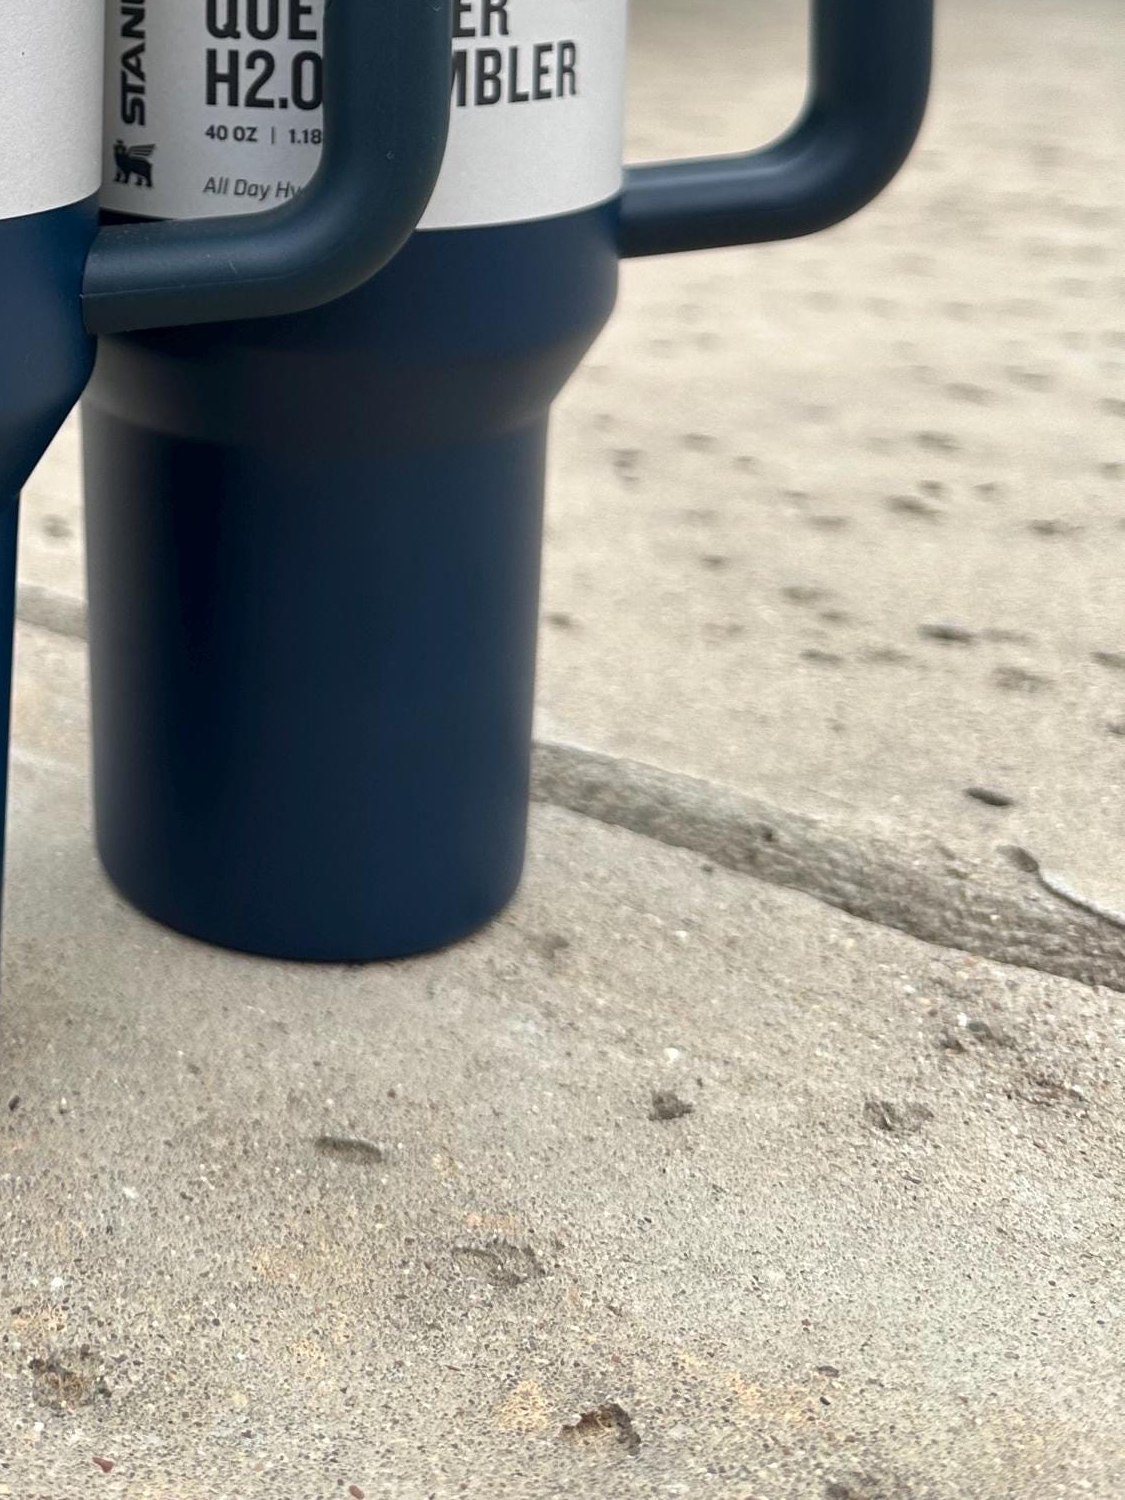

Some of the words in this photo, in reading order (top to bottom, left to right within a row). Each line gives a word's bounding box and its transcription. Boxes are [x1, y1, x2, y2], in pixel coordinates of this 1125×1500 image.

[205, 124, 228, 141] 40
[232, 126, 258, 143] OZ
[288, 128, 322, 145] 1.18
[203, 176, 229, 196] All
[233, 178, 271, 201] Day
